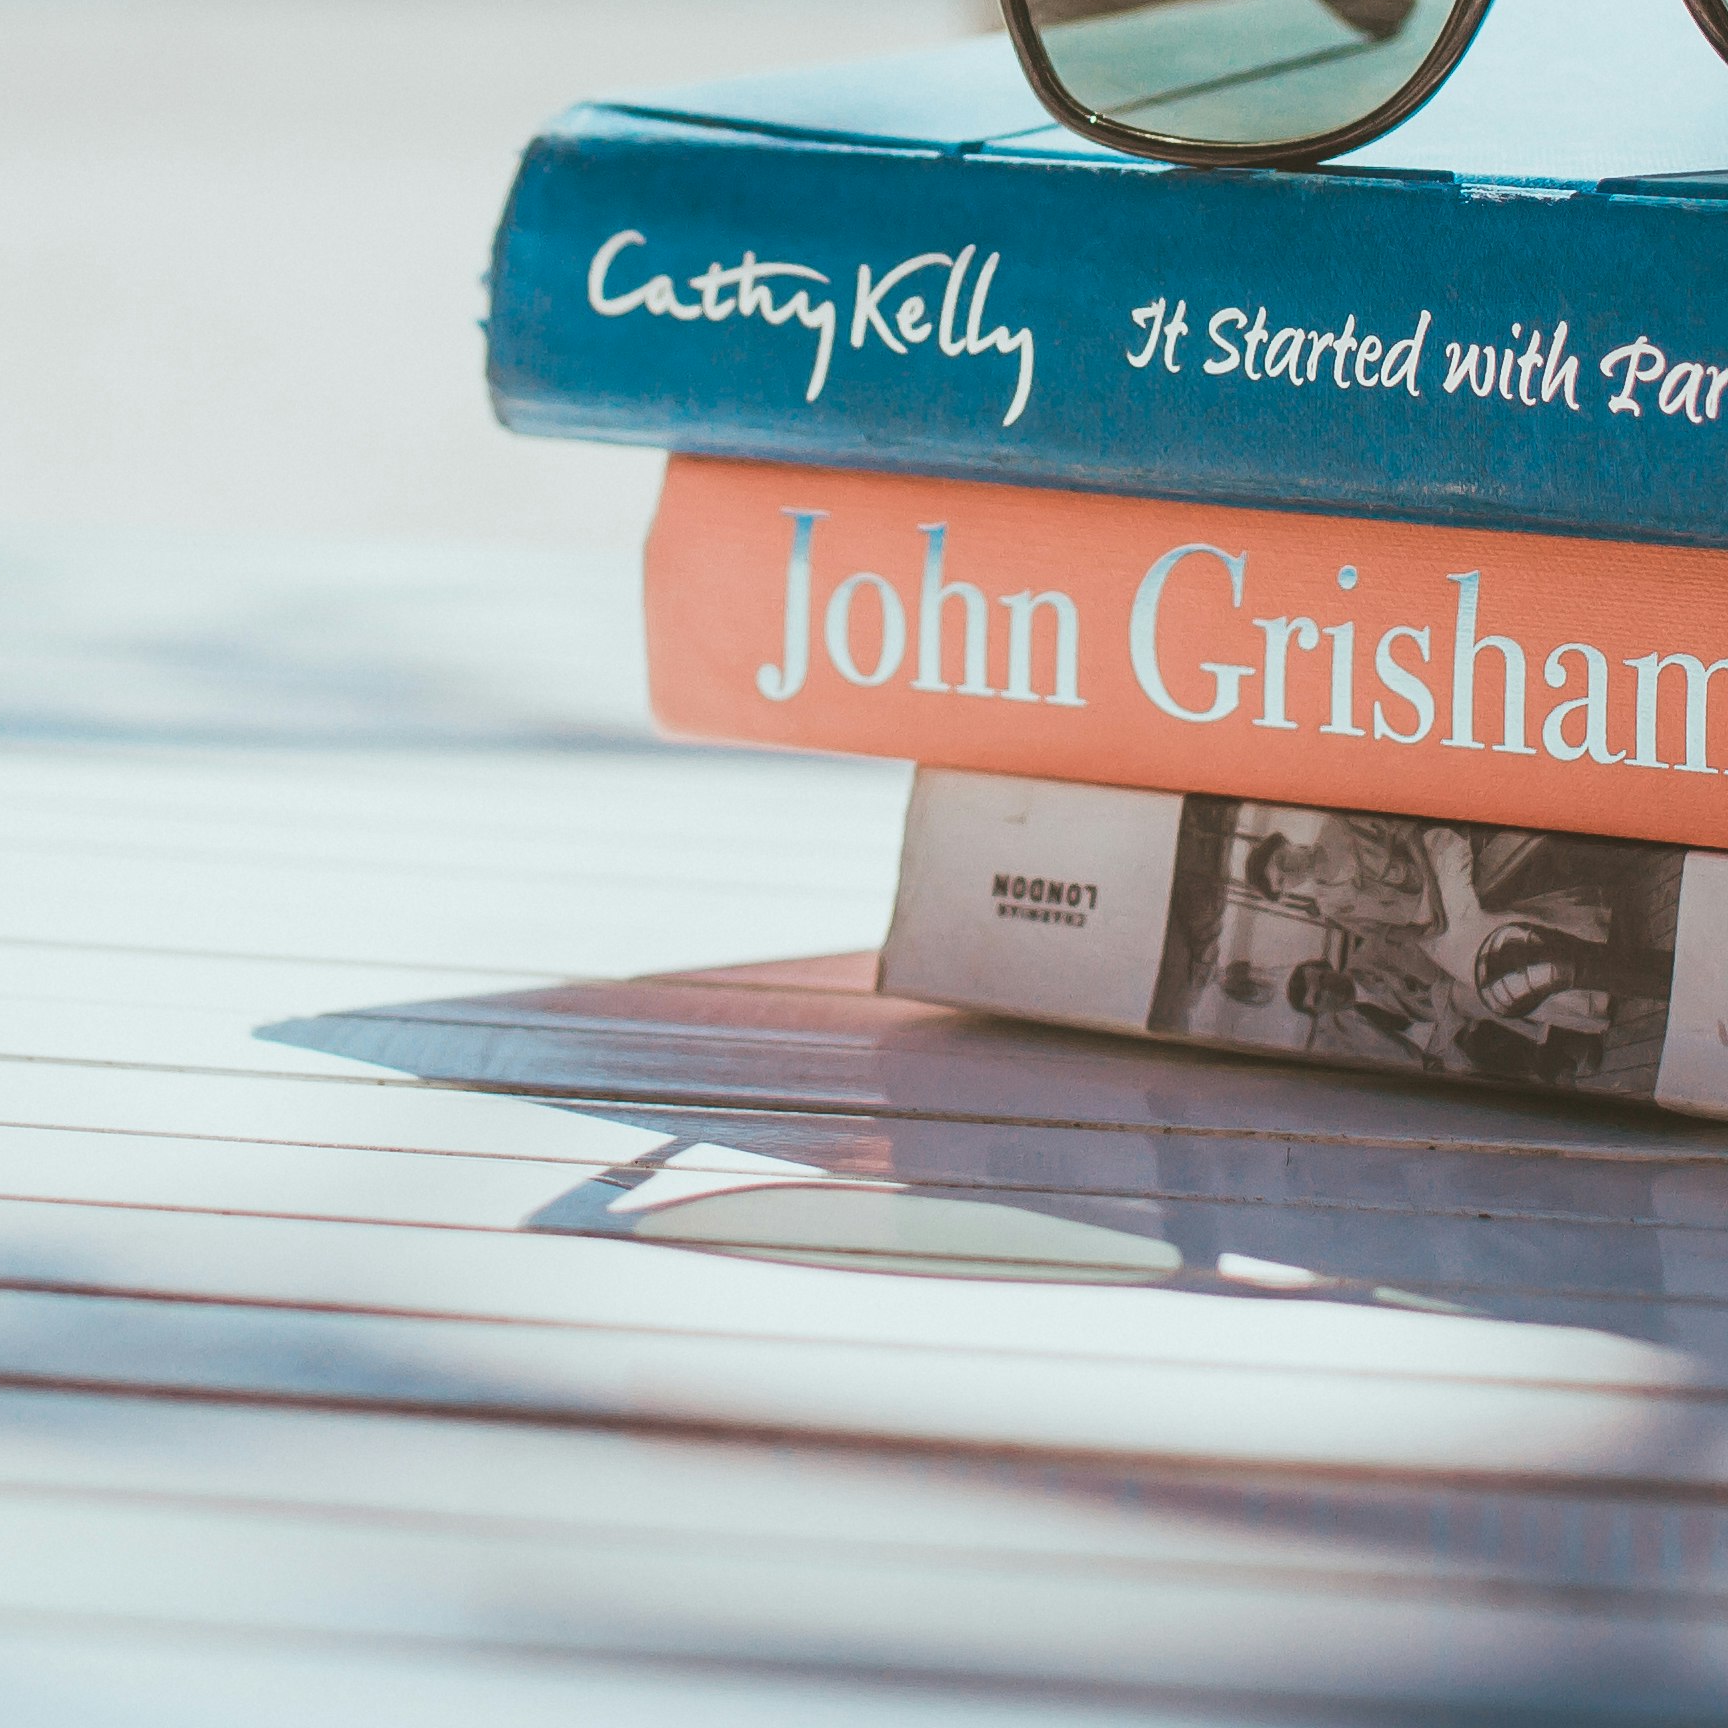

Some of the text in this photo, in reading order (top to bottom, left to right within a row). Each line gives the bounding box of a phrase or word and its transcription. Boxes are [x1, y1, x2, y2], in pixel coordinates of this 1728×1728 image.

[588, 229, 1035, 427] Cathy Kelly
[1125, 297, 1187, 376] It
[1202, 309, 1432, 399] Started
[1442, 321, 1580, 411] with
[755, 507, 1087, 708] John
[991, 874, 1098, 911] LONDON
